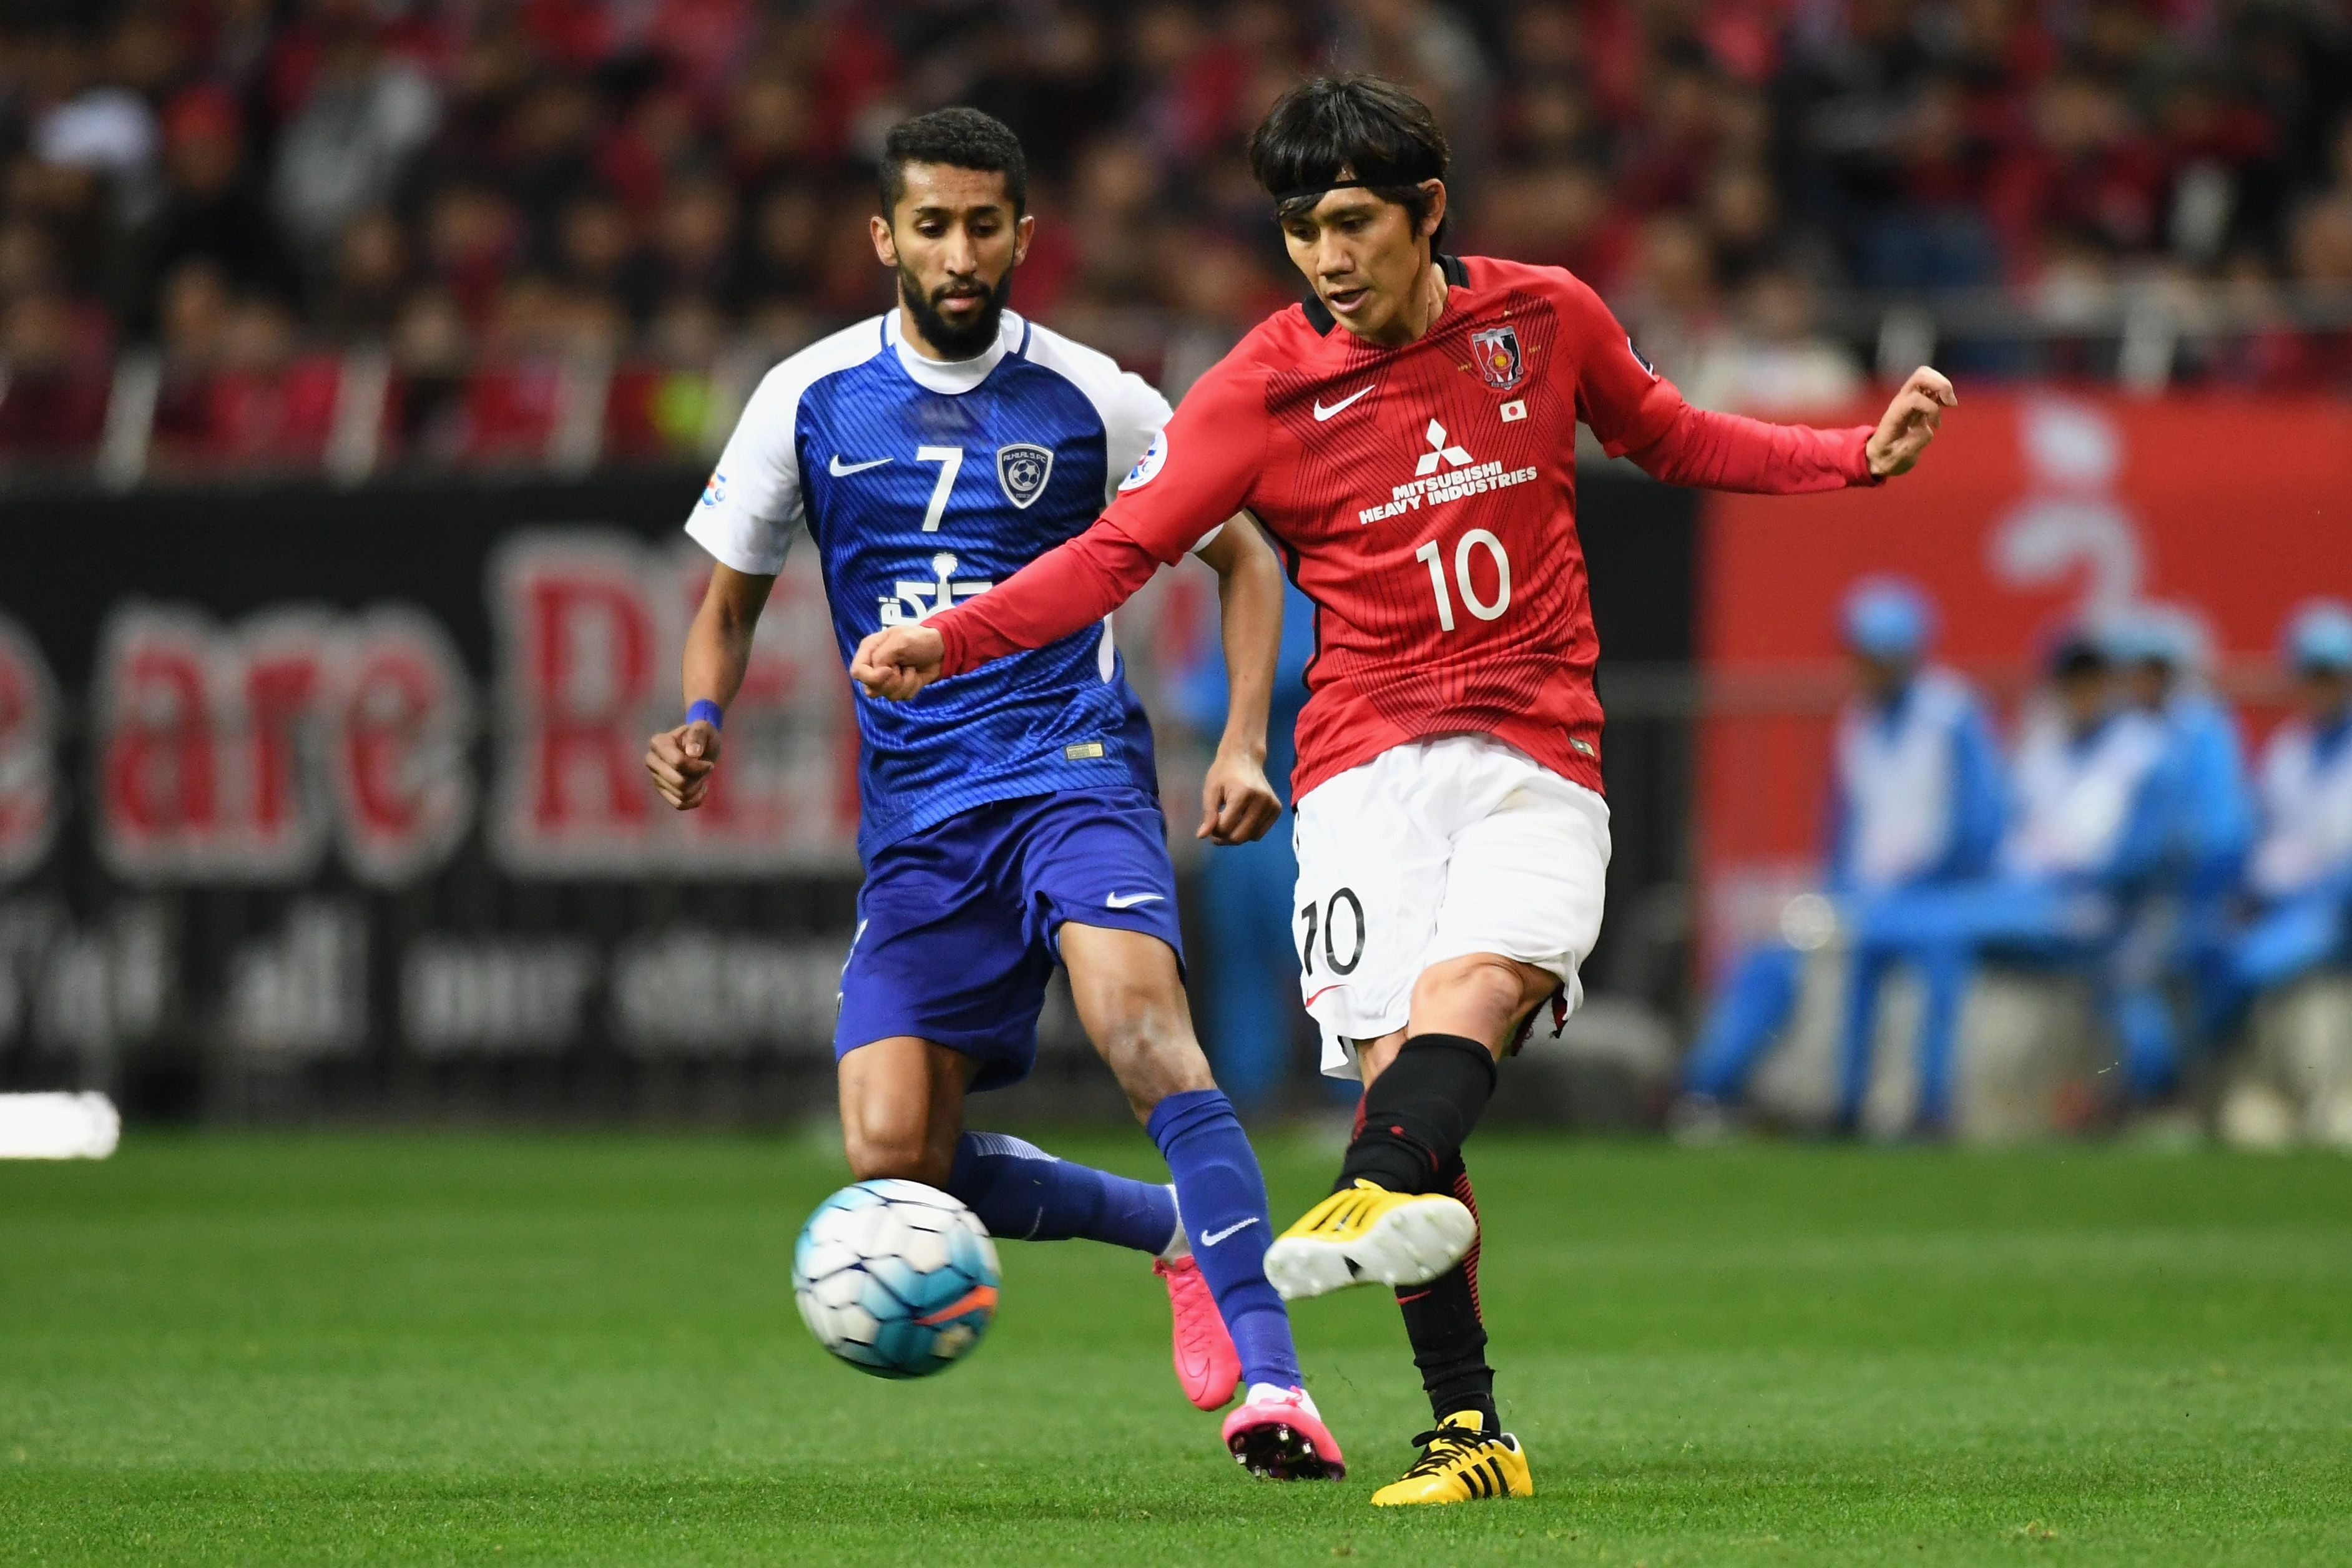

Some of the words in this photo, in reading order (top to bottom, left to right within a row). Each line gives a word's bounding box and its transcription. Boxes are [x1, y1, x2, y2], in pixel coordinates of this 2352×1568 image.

[916, 446, 963, 532] 7
[1358, 494, 1421, 525] HEAVY
[1427, 466, 1538, 506] INDUSTRIES
[1392, 461, 1502, 501] MITSUBISHI
[1416, 528, 1511, 632] 10
[97, 624, 459, 858] are
[1301, 887, 1365, 978] 10
